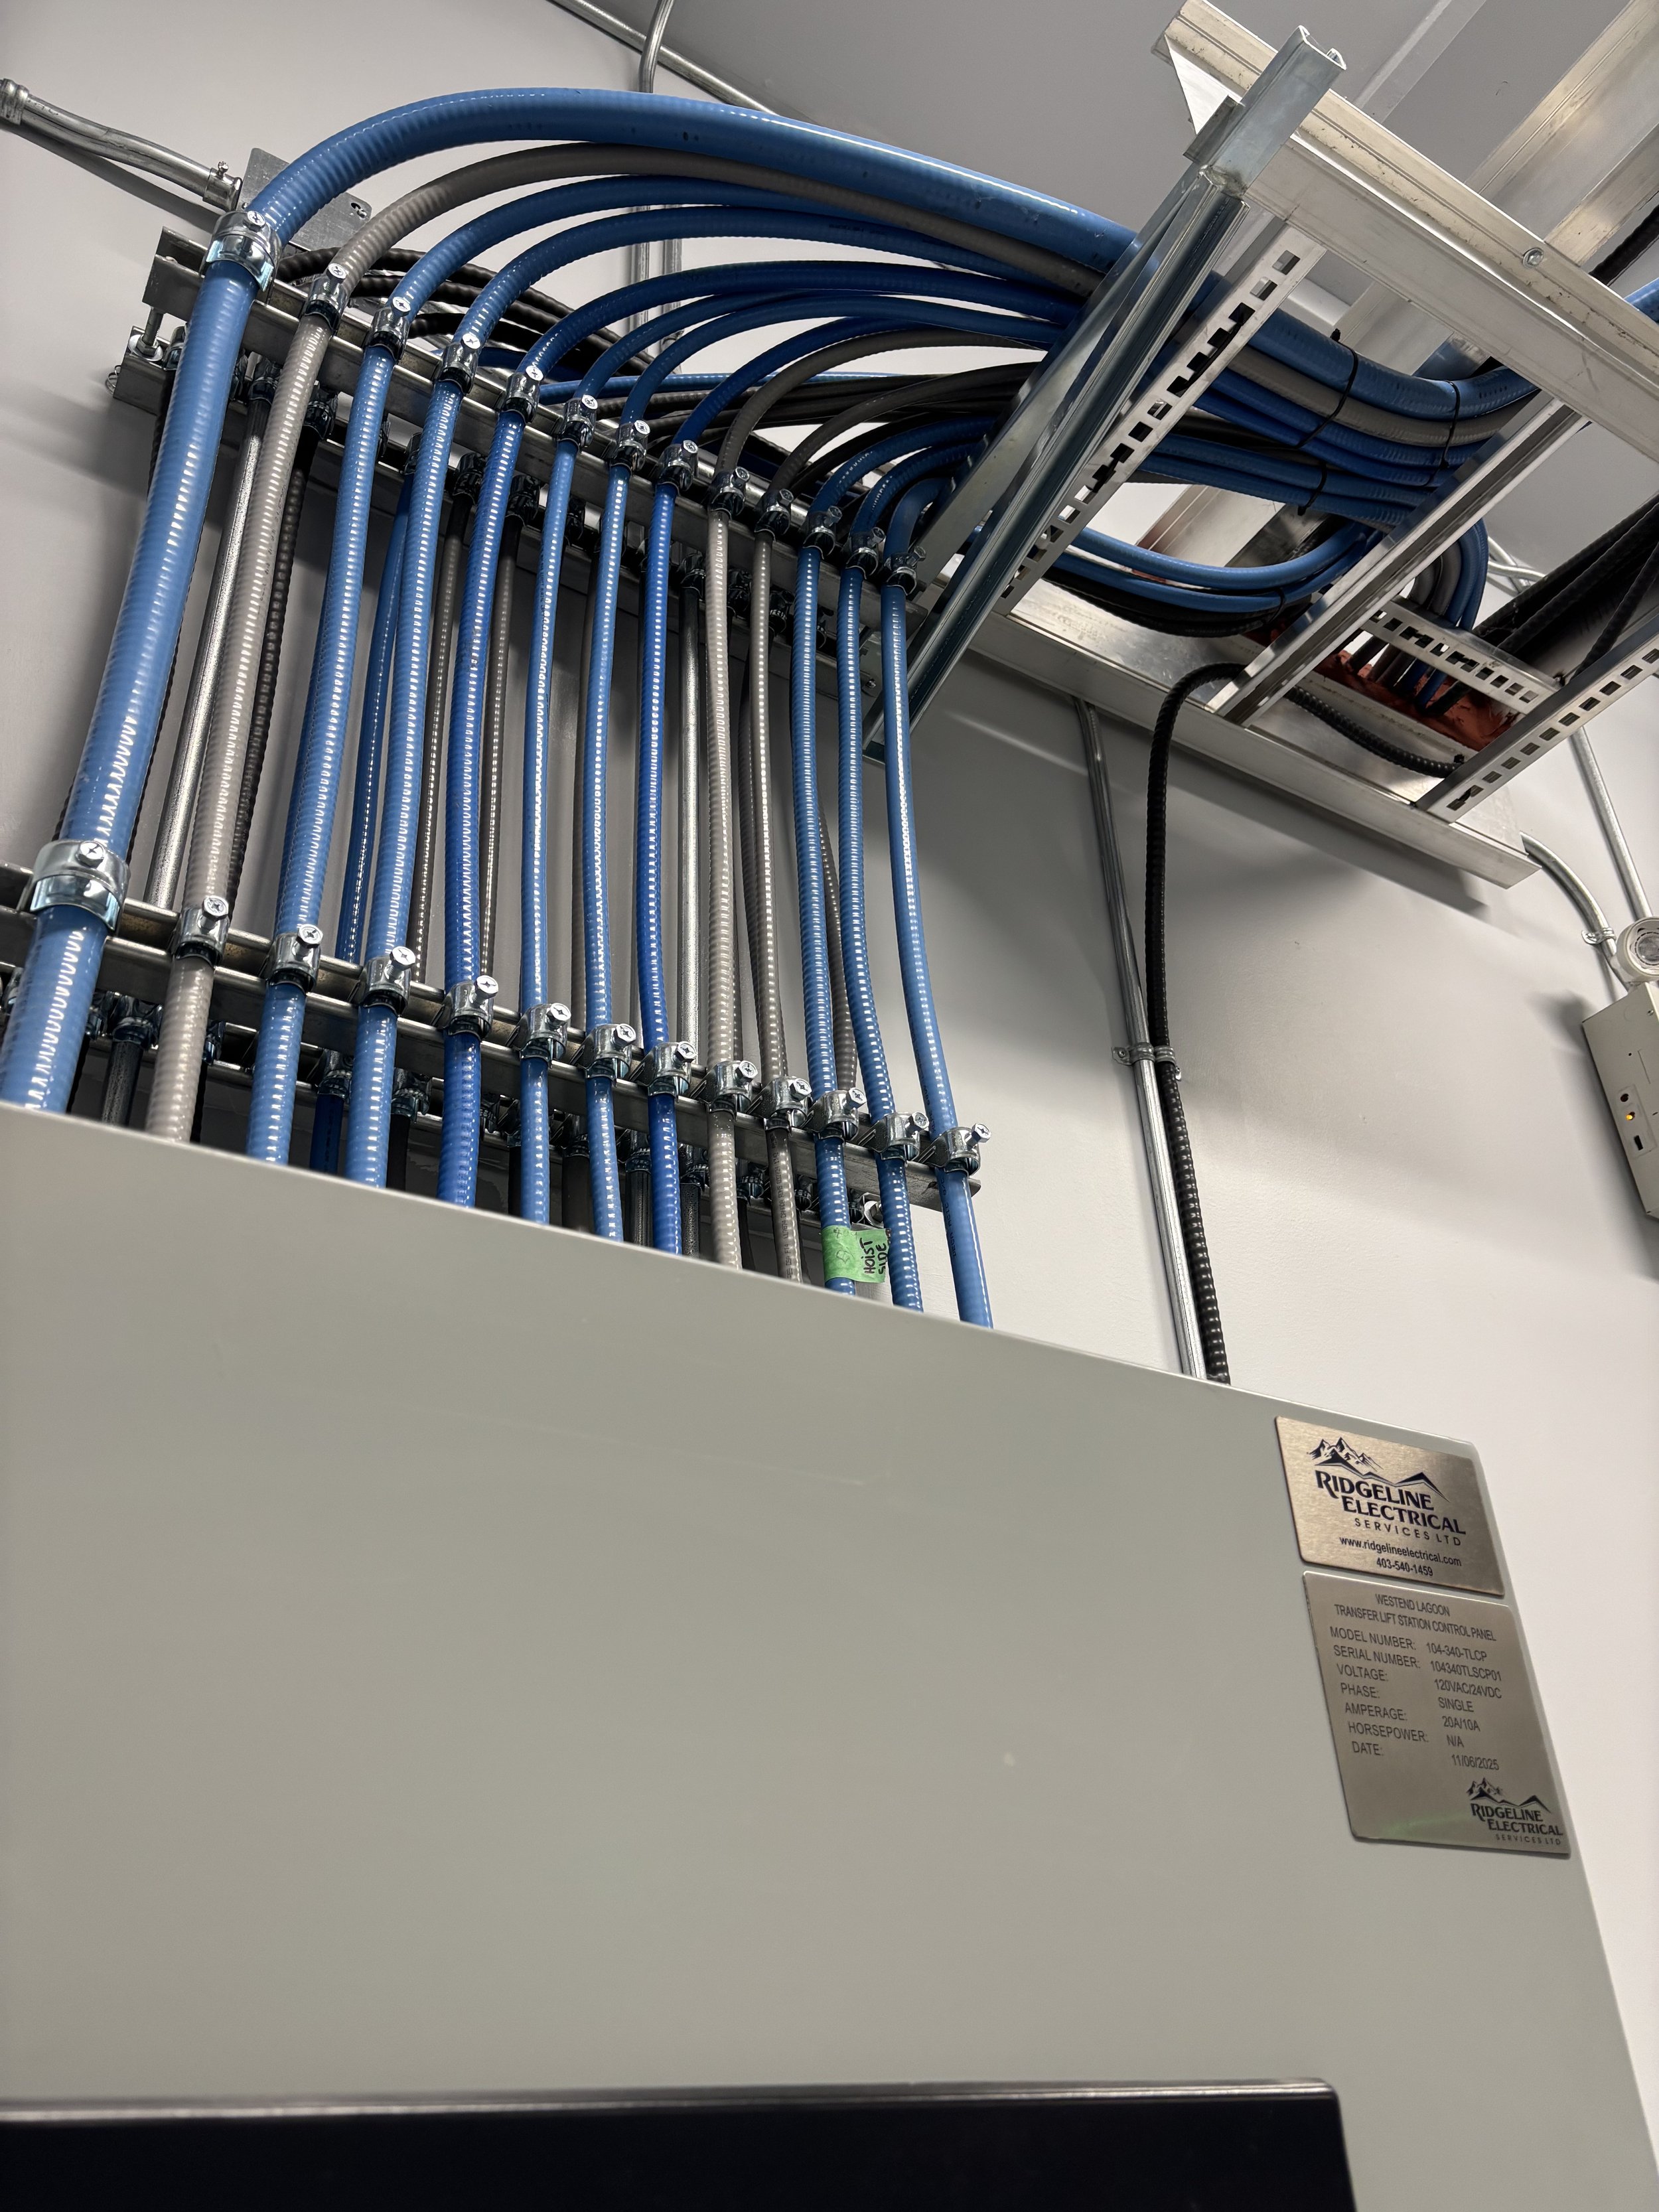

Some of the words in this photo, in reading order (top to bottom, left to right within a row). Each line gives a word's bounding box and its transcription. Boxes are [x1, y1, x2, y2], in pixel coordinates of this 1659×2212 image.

[875, 1243, 888, 1274] SIDE
[1315, 1470, 1434, 1511] RIDGELINE
[1341, 1495, 1466, 1534] ELECTRICAL
[1354, 1518, 1430, 1540] SERVICES
[1436, 1534, 1461, 1546] LTD
[1339, 1537, 1462, 1567] www.ridgelineelectrical.com
[1376, 1558, 1433, 1576] 403-540-1459
[1375, 1593, 1415, 1611] WESTEND
[1416, 1601, 1451, 1617] LAGOON
[1334, 1604, 1378, 1621] TRANSFER
[1379, 1611, 1396, 1624] LIFT
[1398, 1615, 1431, 1631] STATION
[1432, 1621, 1471, 1637] CONTROL
[1471, 1627, 1497, 1641] PANEL
[1330, 1626, 1368, 1643] MODEL
[1369, 1633, 1417, 1650] NUMBER:
[1427, 1643, 1487, 1662] 104-340-TLCP
[1334, 1645, 1372, 1661] SERIAL
[1373, 1651, 1421, 1668] NUMBER:
[1430, 1660, 1502, 1681] 104340TLSCP01
[1336, 1663, 1389, 1682] VOLTAGE:
[1434, 1679, 1502, 1698] 120VAC/24VDC
[1340, 1682, 1380, 1698] PHASE:
[1438, 1697, 1475, 1712] SINGLE
[1345, 1702, 1407, 1720] AMPERAGE:
[1442, 1716, 1481, 1732] 20A/10A
[1348, 1722, 1429, 1742] HORSEPOWER:
[1446, 1734, 1465, 1748] N/A
[1352, 1741, 1384, 1756] DATE:
[1451, 1754, 1500, 1771] 11/06/2025
[1471, 1803, 1544, 1822] RIDGELINE
[1487, 1819, 1563, 1836] ELECTRICAL
[1496, 1834, 1542, 1844] SERVICES
